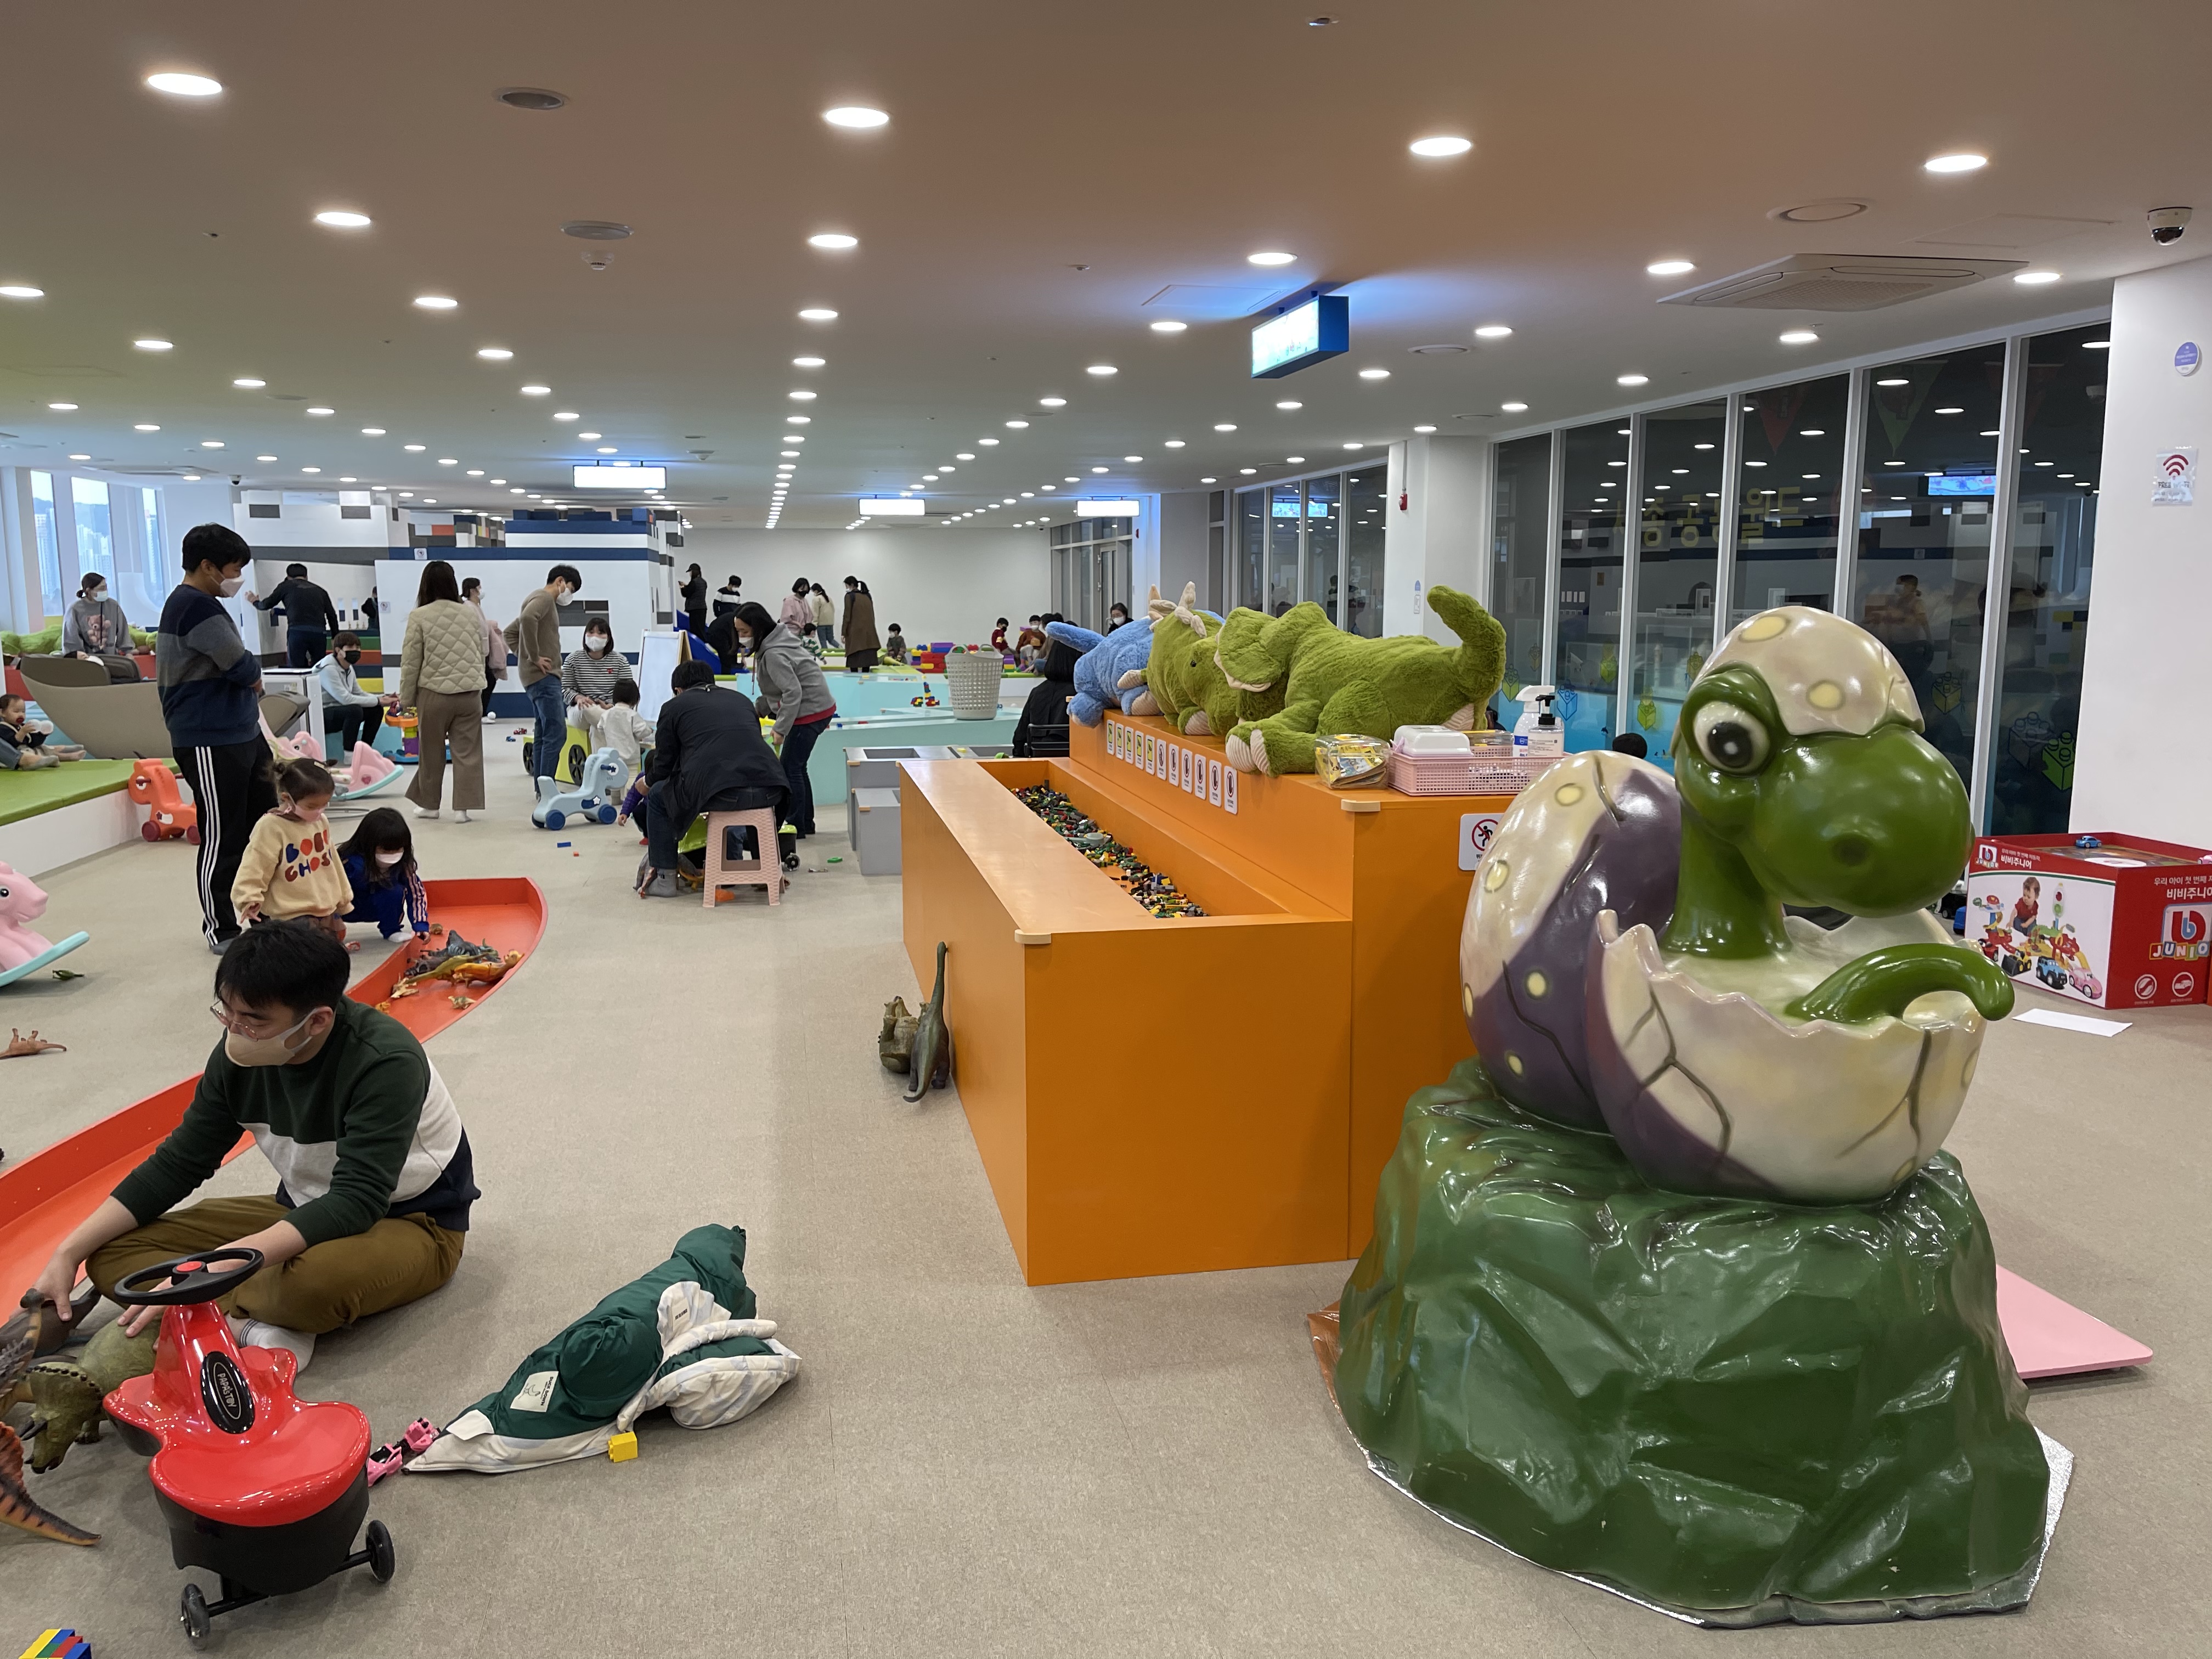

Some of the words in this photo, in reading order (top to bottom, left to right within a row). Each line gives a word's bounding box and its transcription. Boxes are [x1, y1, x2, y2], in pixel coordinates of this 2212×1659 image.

[1976, 858, 1999, 868] JUNIOR
[2001, 855, 2032, 869] 비비주니어
[2154, 877, 2168, 885] 우리
[2169, 877, 2183, 885] 아이
[2185, 876, 2192, 884] 첫
[2193, 876, 2207, 884] 번째
